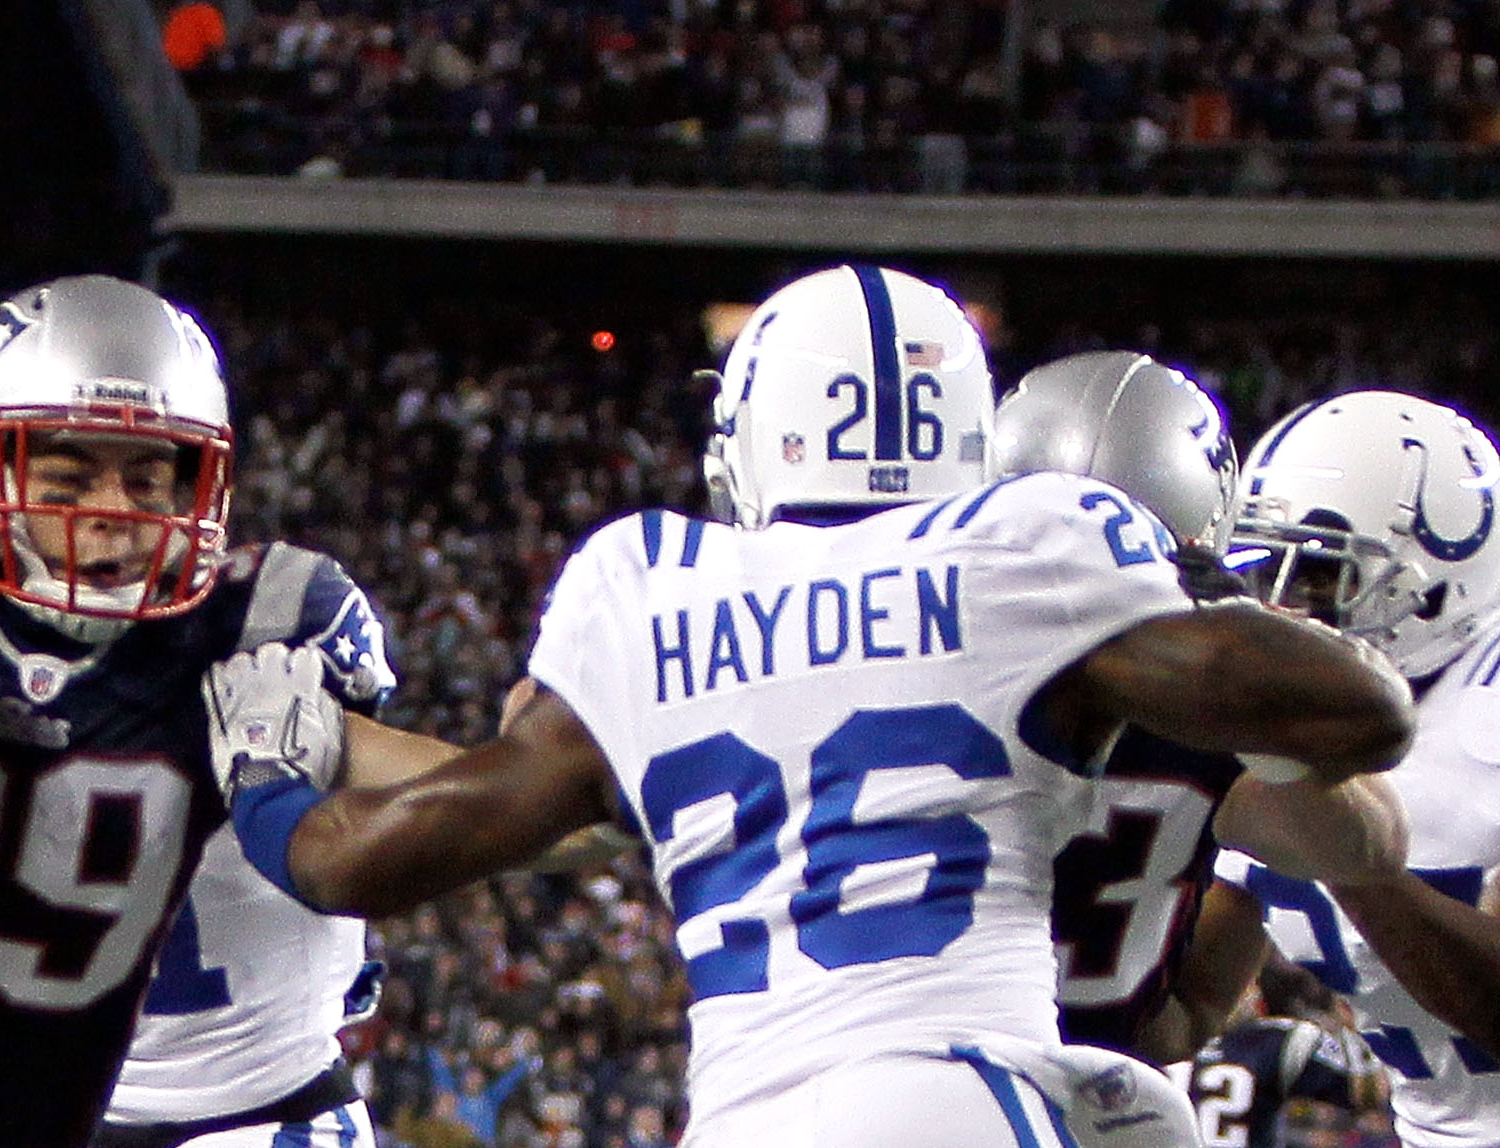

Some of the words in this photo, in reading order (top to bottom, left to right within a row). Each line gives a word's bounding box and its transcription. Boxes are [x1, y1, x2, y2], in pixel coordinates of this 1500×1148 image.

[827, 372, 944, 461] 26
[651, 565, 963, 703] HAYDEN
[640, 703, 1014, 1001] 26
